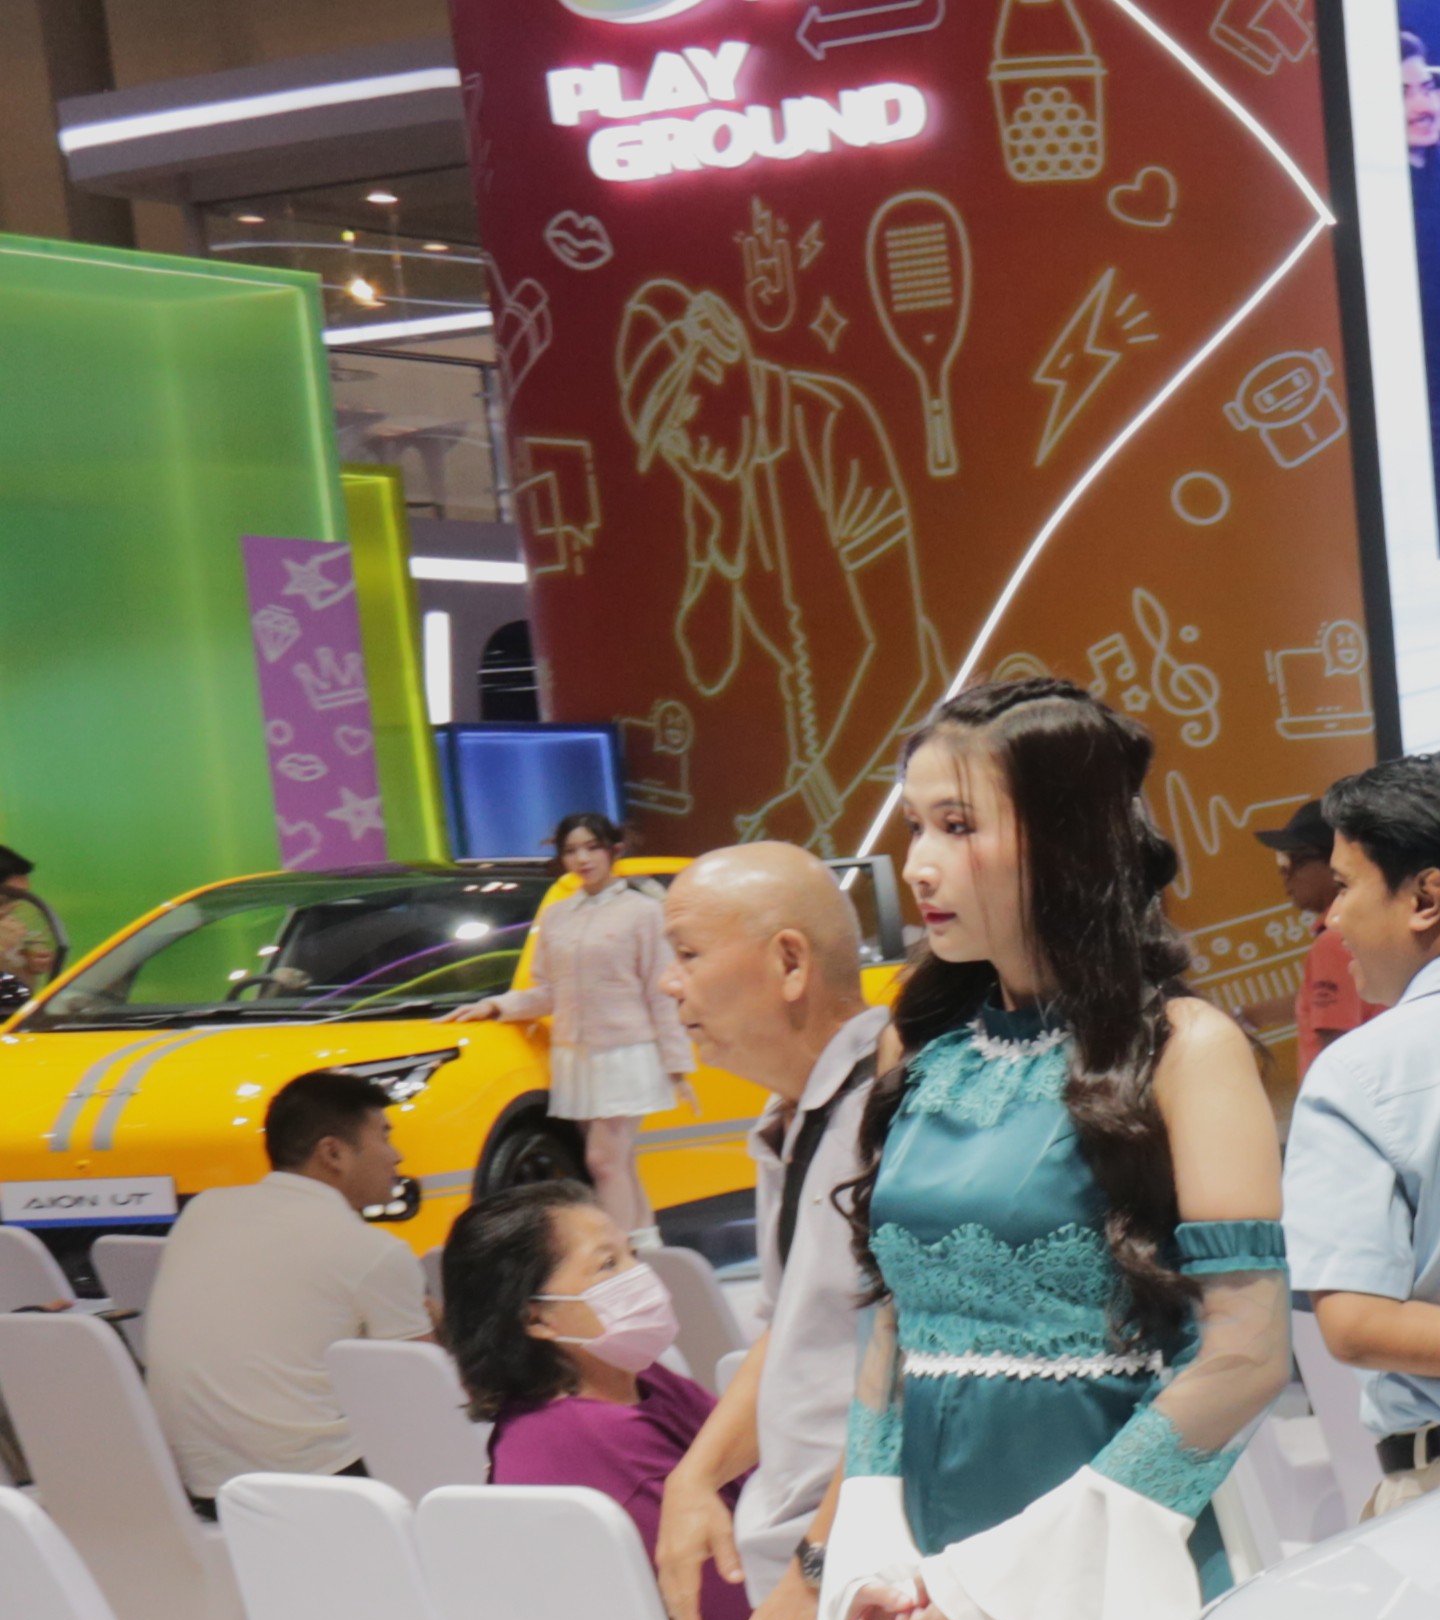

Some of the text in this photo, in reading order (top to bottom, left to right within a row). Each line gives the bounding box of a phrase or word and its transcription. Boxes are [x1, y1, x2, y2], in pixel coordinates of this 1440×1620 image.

[547, 41, 750, 126] PLAY
[588, 82, 927, 182] GROUND
[23, 1192, 152, 1209] AION UT
